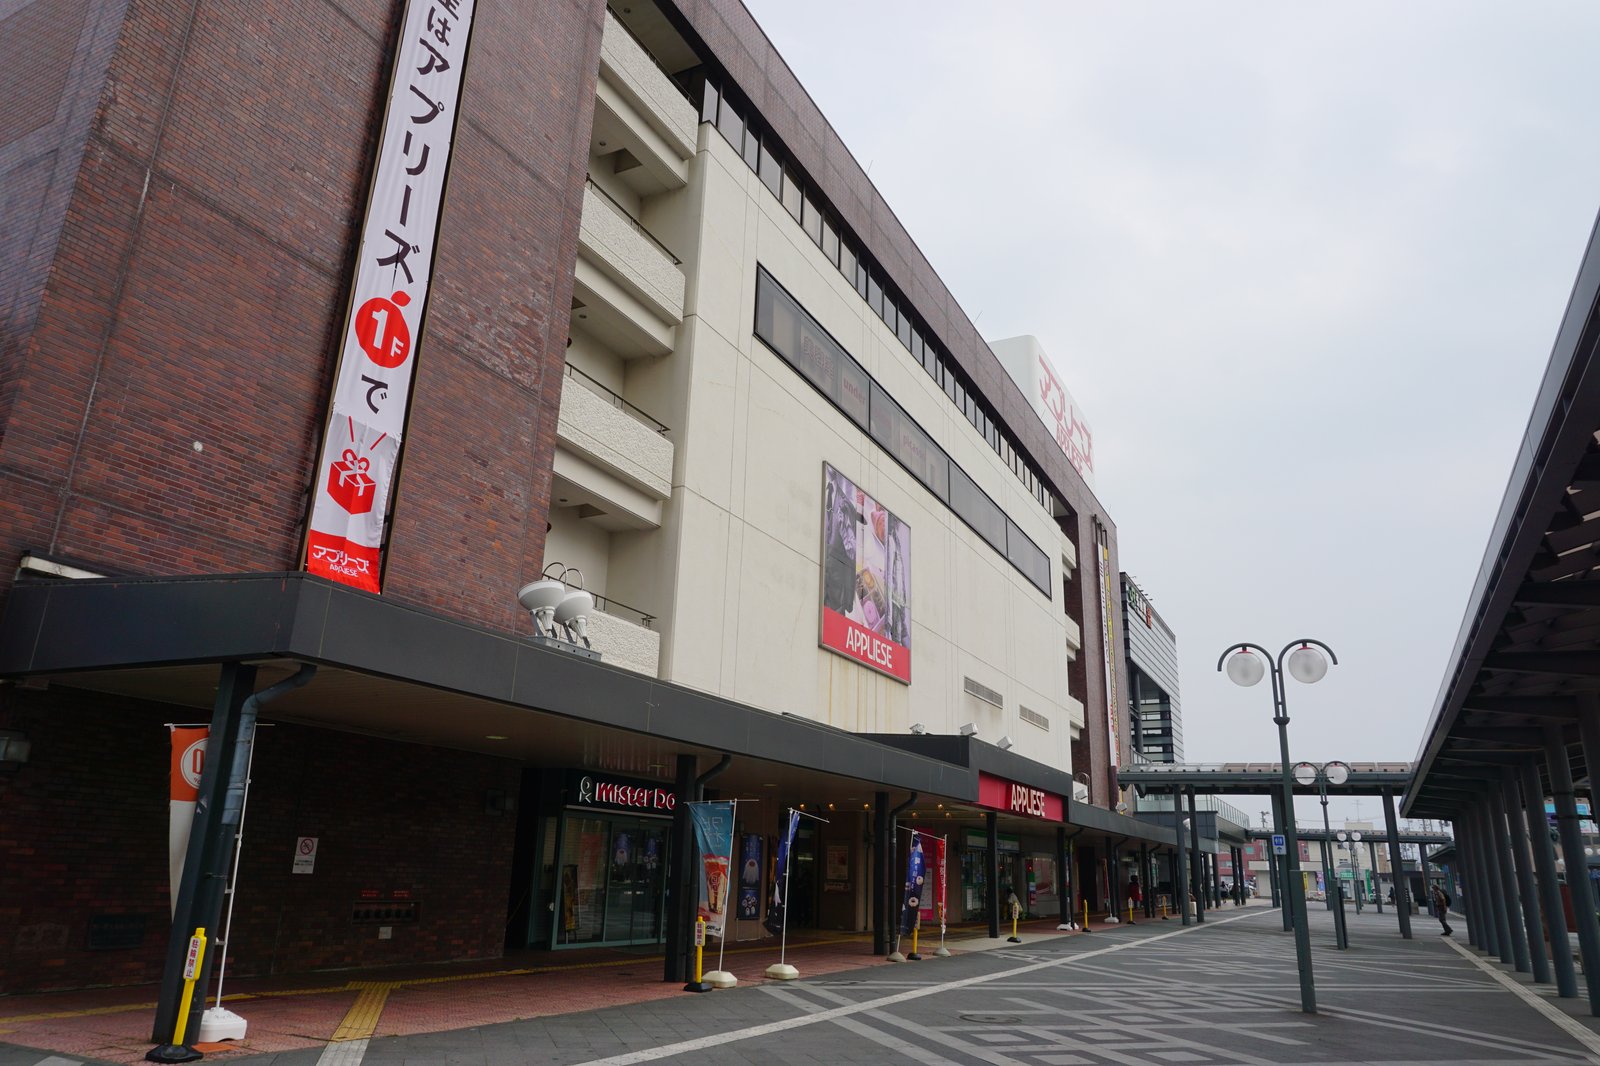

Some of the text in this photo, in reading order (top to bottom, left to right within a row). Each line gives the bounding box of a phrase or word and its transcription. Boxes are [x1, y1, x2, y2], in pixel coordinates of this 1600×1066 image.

[312, 544, 370, 574] アプリーズ
[846, 626, 893, 669] APPLIESE
[595, 782, 676, 810] mister Do
[1010, 783, 1046, 817] APPLIESE
